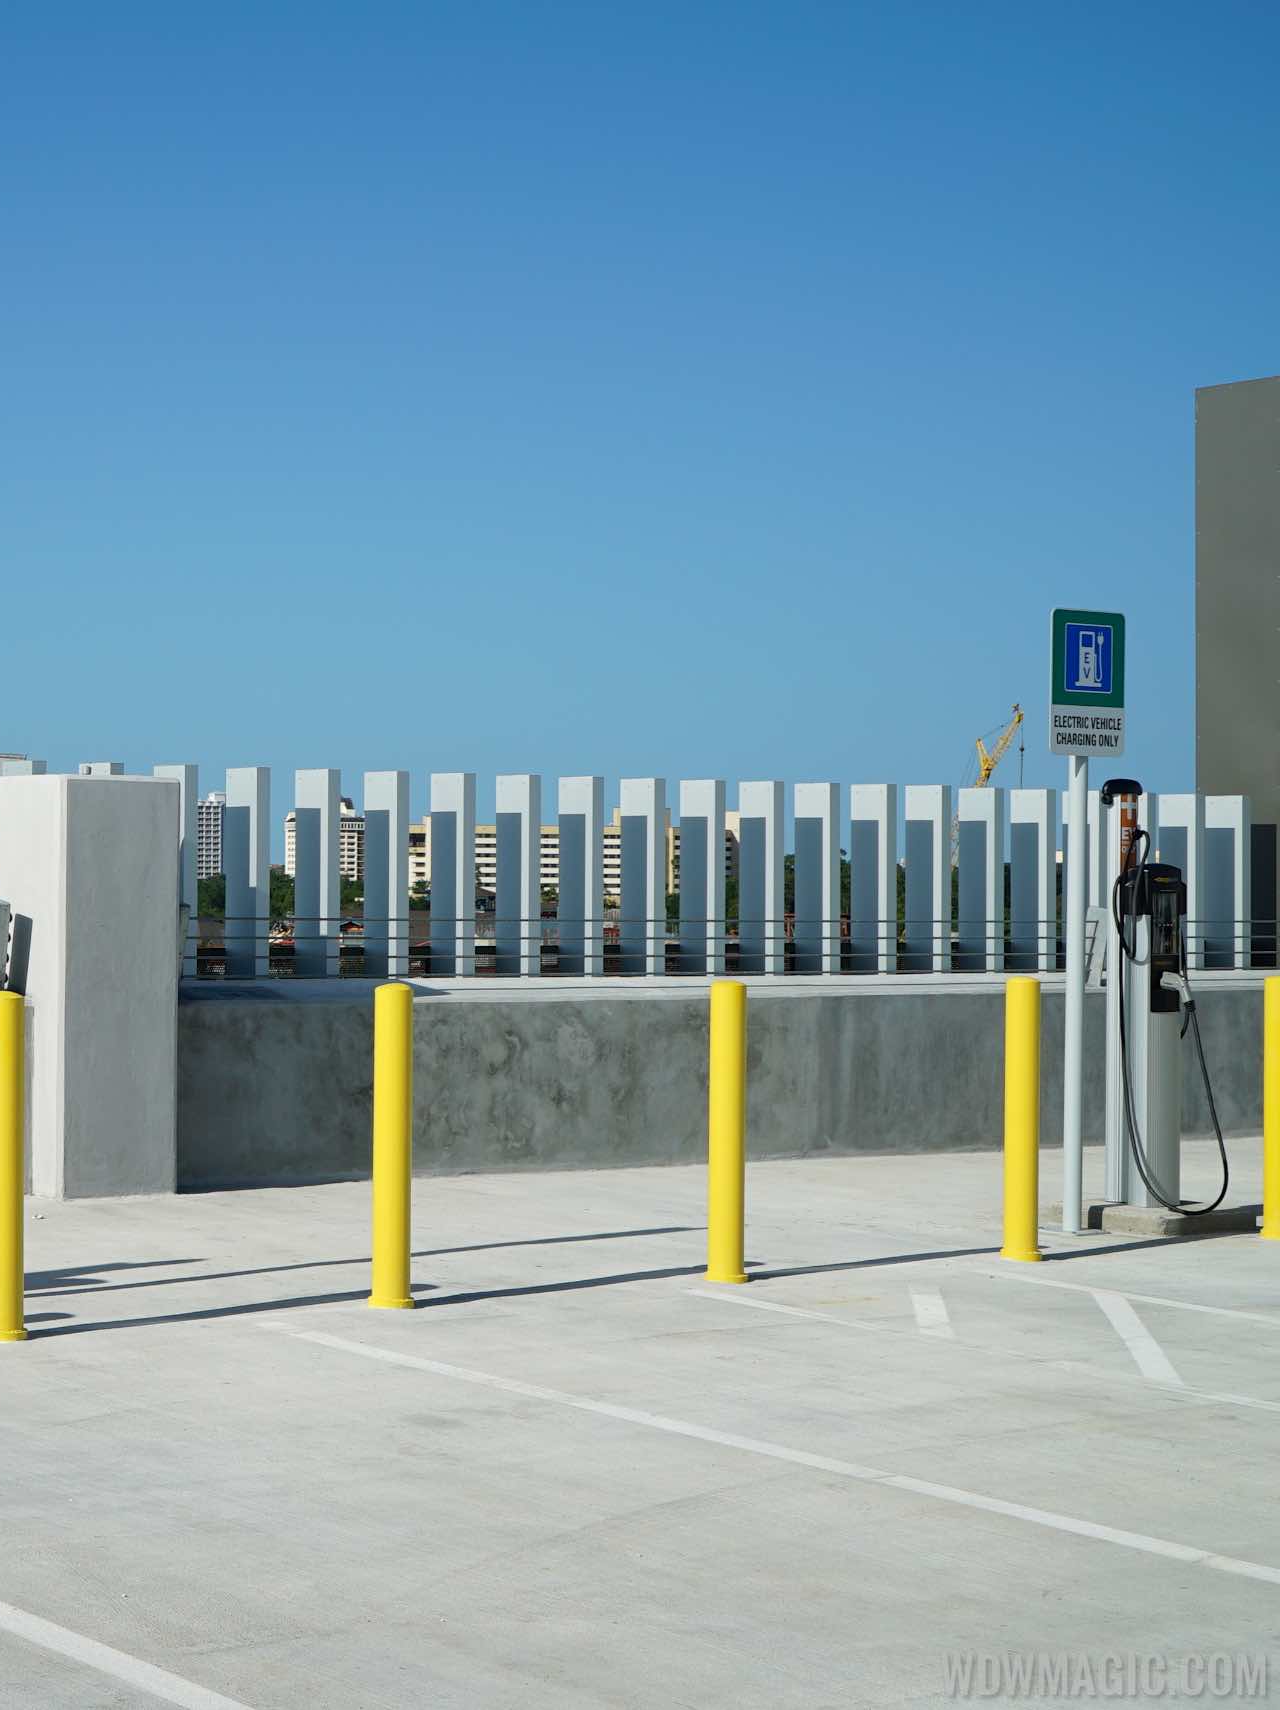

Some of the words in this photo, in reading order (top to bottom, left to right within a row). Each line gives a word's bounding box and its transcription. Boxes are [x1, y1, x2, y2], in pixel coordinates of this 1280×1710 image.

[1054, 715, 1089, 729] ELECTRIC
[1090, 717, 1122, 731] VEHICLE
[1056, 732, 1097, 747] CHARGING
[1098, 734, 1119, 747] ONLY
